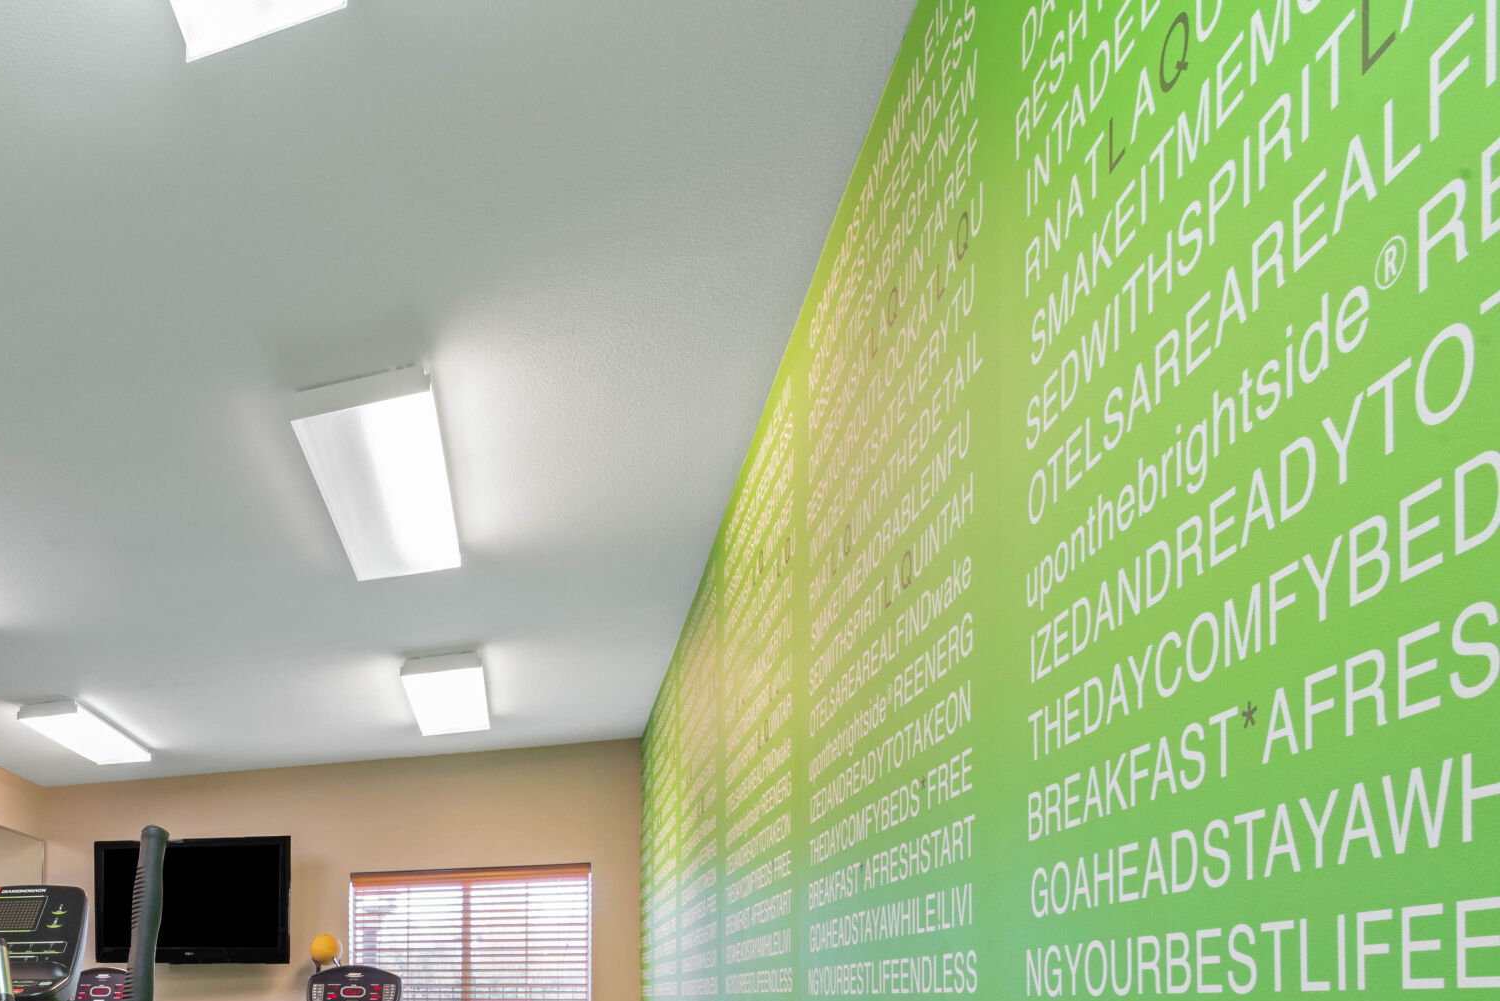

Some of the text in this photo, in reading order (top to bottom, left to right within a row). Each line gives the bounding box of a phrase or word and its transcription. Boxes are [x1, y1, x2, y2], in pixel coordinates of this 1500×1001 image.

[808, 120, 977, 483] DAYBEGINSATLAQUINTAREF
[809, 49, 977, 439] POSSIBILITIESABRIGHTNEW
[810, 0, 952, 348] GOAHEADSTAYAWHILE!L
[807, 183, 982, 528] RESHYOUROUTLOOKATLAQU
[809, 332, 982, 608] RNATLAQUINTATHEDETAIL
[810, 264, 974, 565] INTADELIGHTSATEVERYTU
[809, 473, 972, 695] SEDWITHSPIRITLAQUINTAH
[810, 557, 971, 736] OTELSAREAREALFINDwake
[811, 411, 969, 649] SMAKEITMEMORABLEINFU
[810, 681, 970, 822] IZEDANDREADYTOTAKEON
[808, 950, 977, 994] NGYOURBESTLIFEENDLESS
[810, 884, 971, 951] GOAHEADSTAYAWHILE!LIVI
